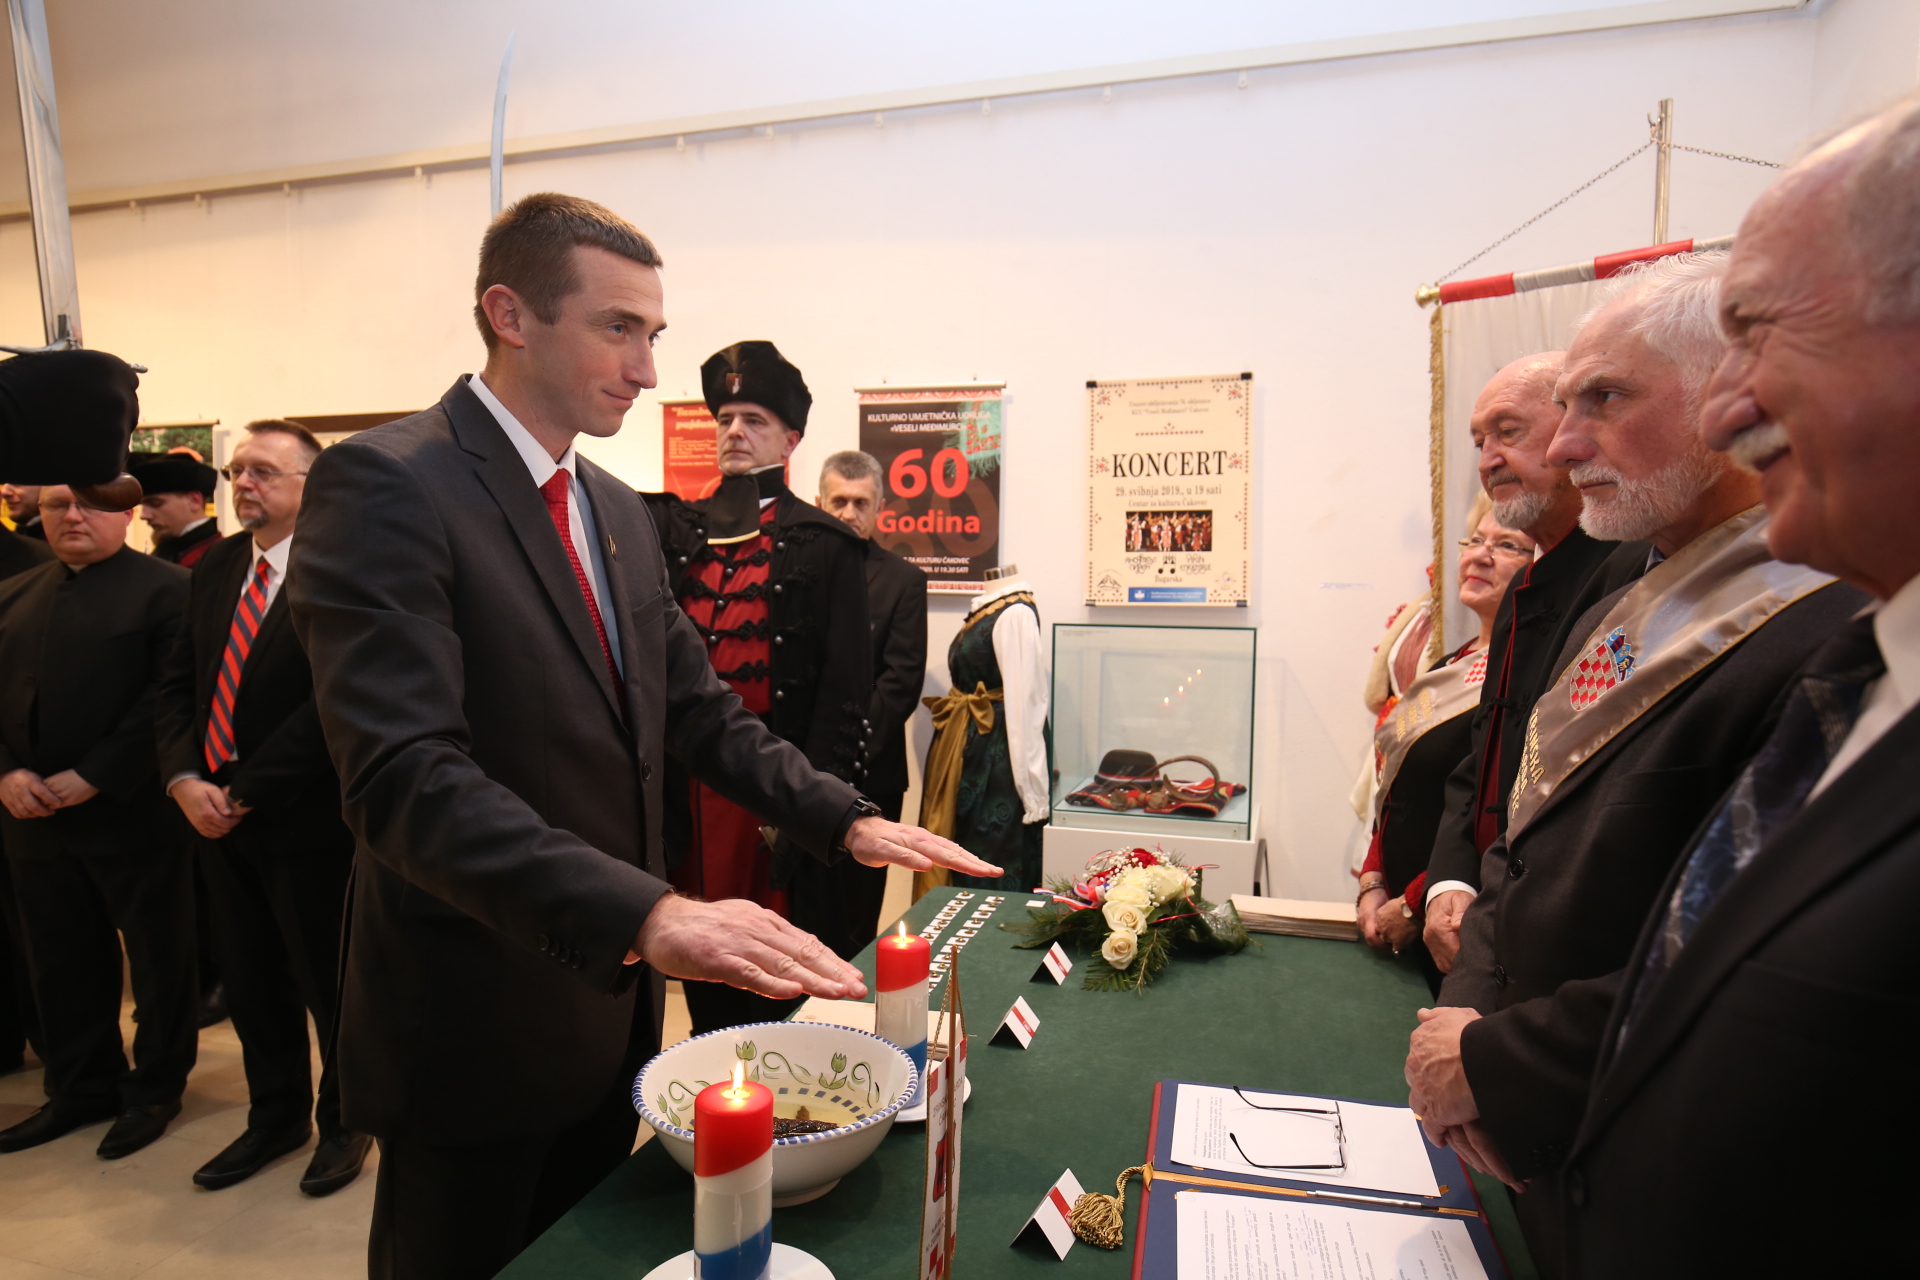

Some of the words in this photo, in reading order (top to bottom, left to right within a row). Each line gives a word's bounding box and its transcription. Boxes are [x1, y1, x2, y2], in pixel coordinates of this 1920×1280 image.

[867, 412, 908, 423] KULTURNO
[908, 410, 957, 422] UMJETNIČKA
[1112, 450, 1228, 478] KONCERT
[889, 447, 970, 498] 60
[1115, 486, 1127, 497] 29.
[1128, 485, 1159, 498] svibnja
[1186, 487, 1192, 495] u
[1195, 484, 1204, 495] 19
[1206, 484, 1222, 495] sati
[1128, 499, 1149, 507] Centar
[1158, 499, 1181, 507] kulturu
[1182, 497, 1208, 506] Čakovec
[876, 509, 981, 533] Godina
[916, 556, 942, 565] KULTURU
[942, 556, 971, 565] ČAKOVEC
[934, 566, 940, 574] U
[956, 566, 969, 574] SATI
[1154, 575, 1183, 583] Bugarska
[1529, 707, 1546, 785] ZRINSKA
